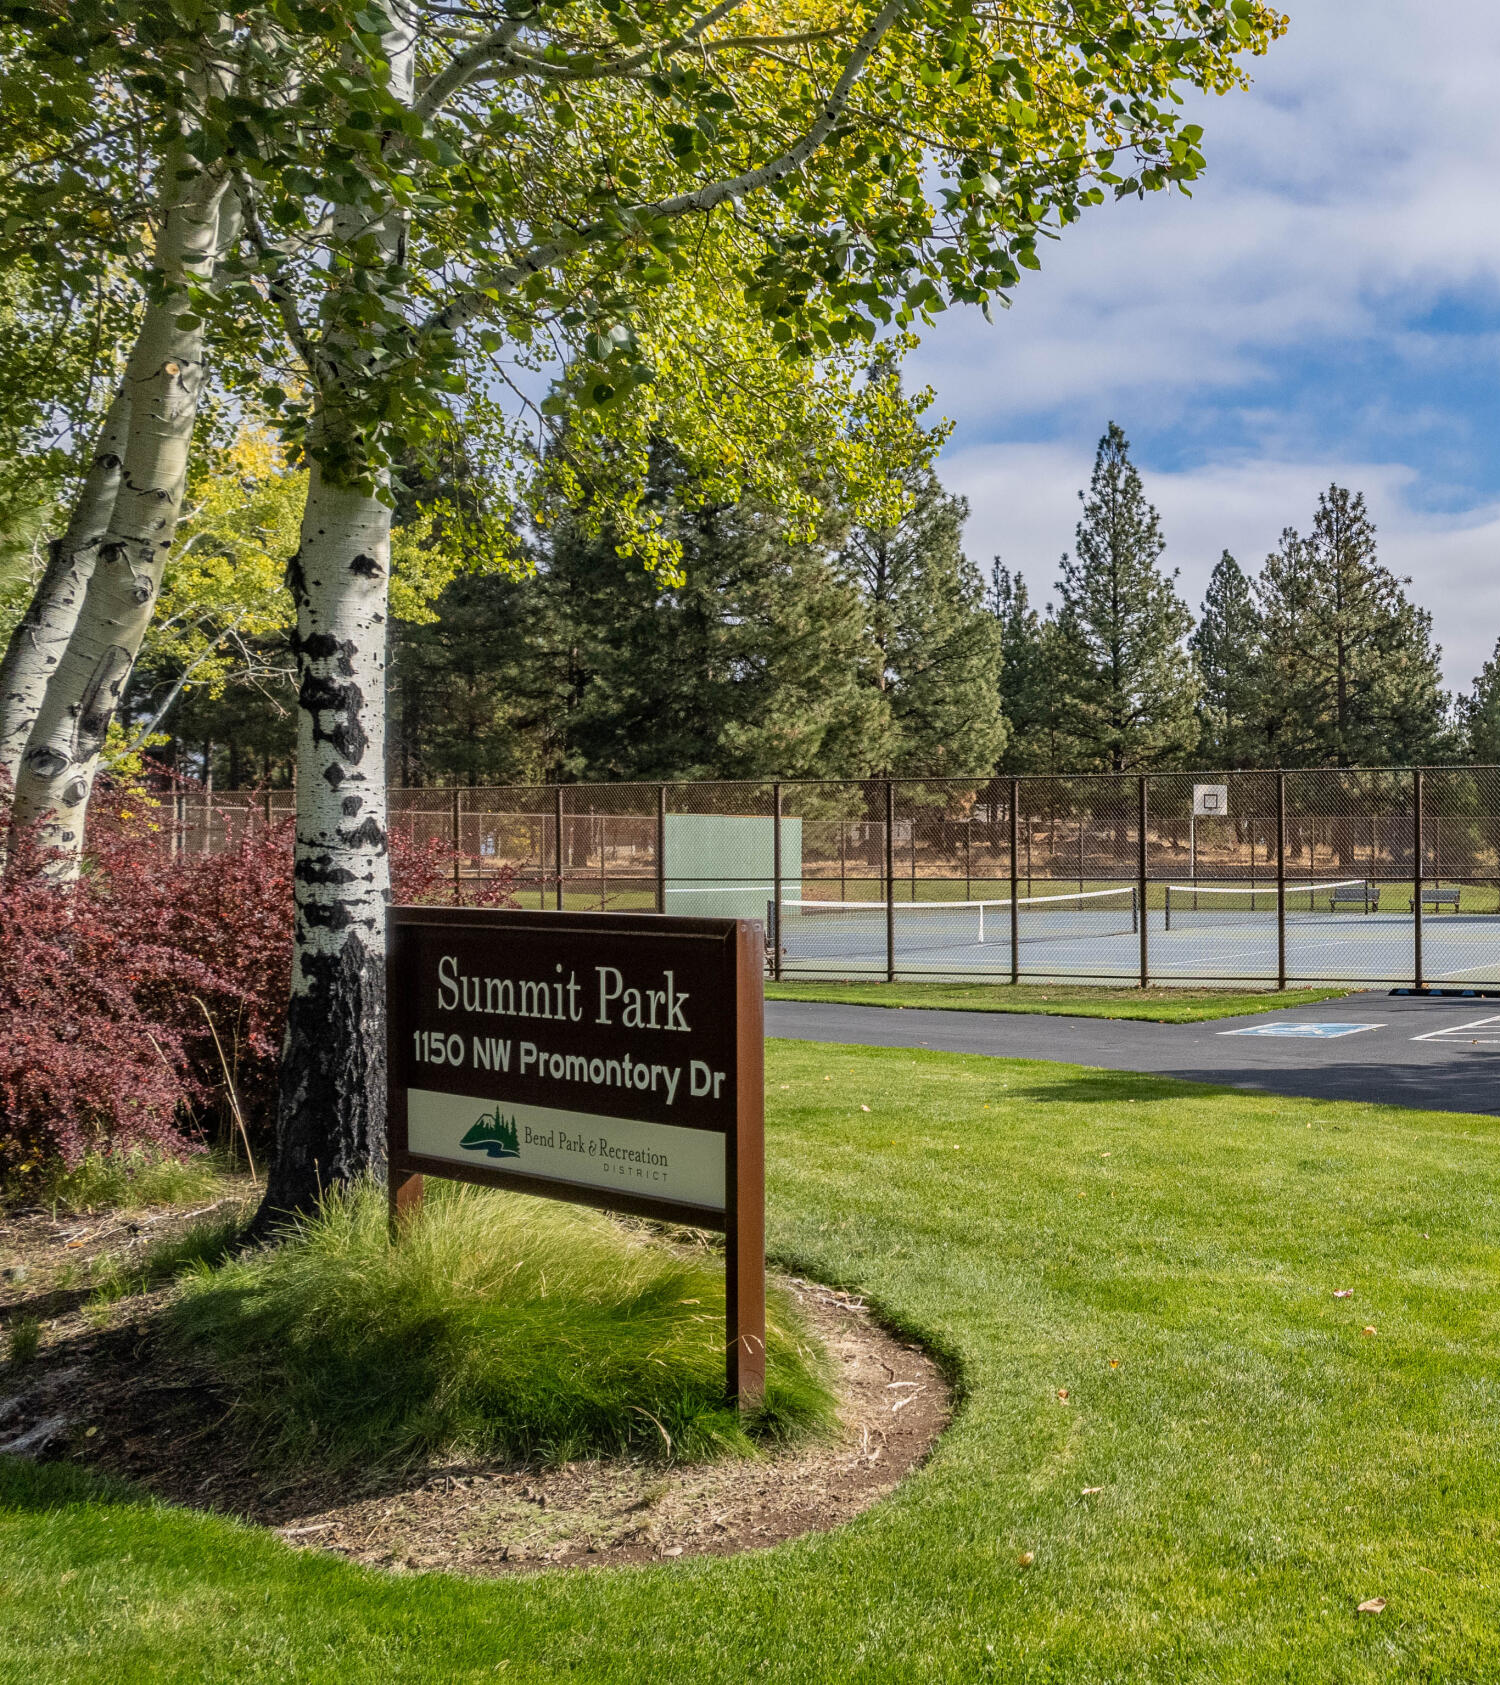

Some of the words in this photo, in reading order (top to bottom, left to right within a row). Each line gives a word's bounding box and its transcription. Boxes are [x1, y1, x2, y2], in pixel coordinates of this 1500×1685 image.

[438, 955, 583, 1022] Summit
[595, 966, 692, 1032] Park
[413, 1030, 465, 1067] 1150
[473, 1036, 511, 1072] NW
[520, 1041, 681, 1105] Promontory
[690, 1059, 726, 1099] Dr
[524, 1126, 554, 1148] Bend
[559, 1131, 585, 1153] Park
[588, 1140, 597, 1157] &
[599, 1138, 668, 1167] Recreation
[603, 1162, 668, 1182] DISTRICT
